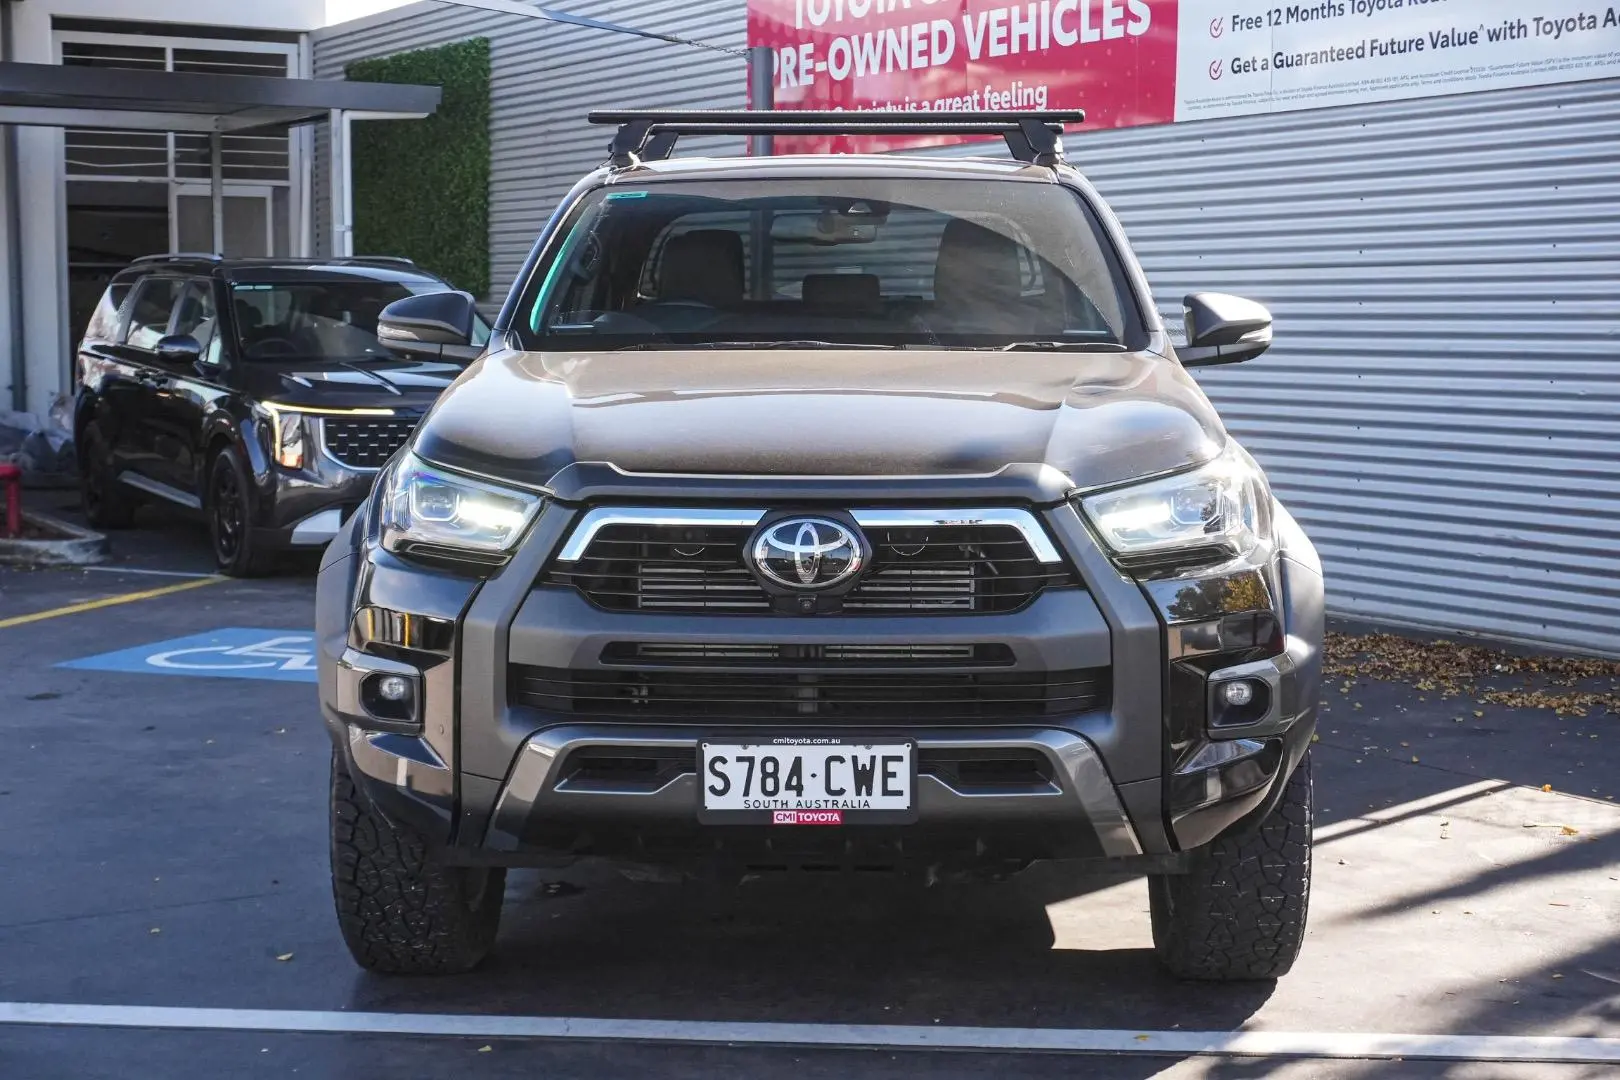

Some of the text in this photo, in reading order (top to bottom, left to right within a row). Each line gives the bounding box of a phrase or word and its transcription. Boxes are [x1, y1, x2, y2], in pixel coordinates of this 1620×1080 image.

[795, 0, 911, 29] TOY
[1231, 15, 1263, 32] Free
[1266, 9, 1282, 27] 12
[1286, 1, 1345, 24] Months
[773, 0, 1152, 89] RE-OWNED VEHICLES
[1230, 56, 1257, 74] Get
[1261, 58, 1269, 71] a
[1273, 40, 1365, 70] Guaranteed
[1370, 37, 1424, 57] Future
[1487, 19, 1527, 42] with
[1533, 13, 1597, 39] Toyota
[1603, 7, 1620, 28] A
[934, 90, 980, 112] great
[983, 81, 1047, 110] feeling
[773, 737, 841, 745] cmitoyota.com.au
[744, 799, 871, 809] SOUTH AUSTRALIA
[775, 813, 841, 822] CMI TOYOTA
